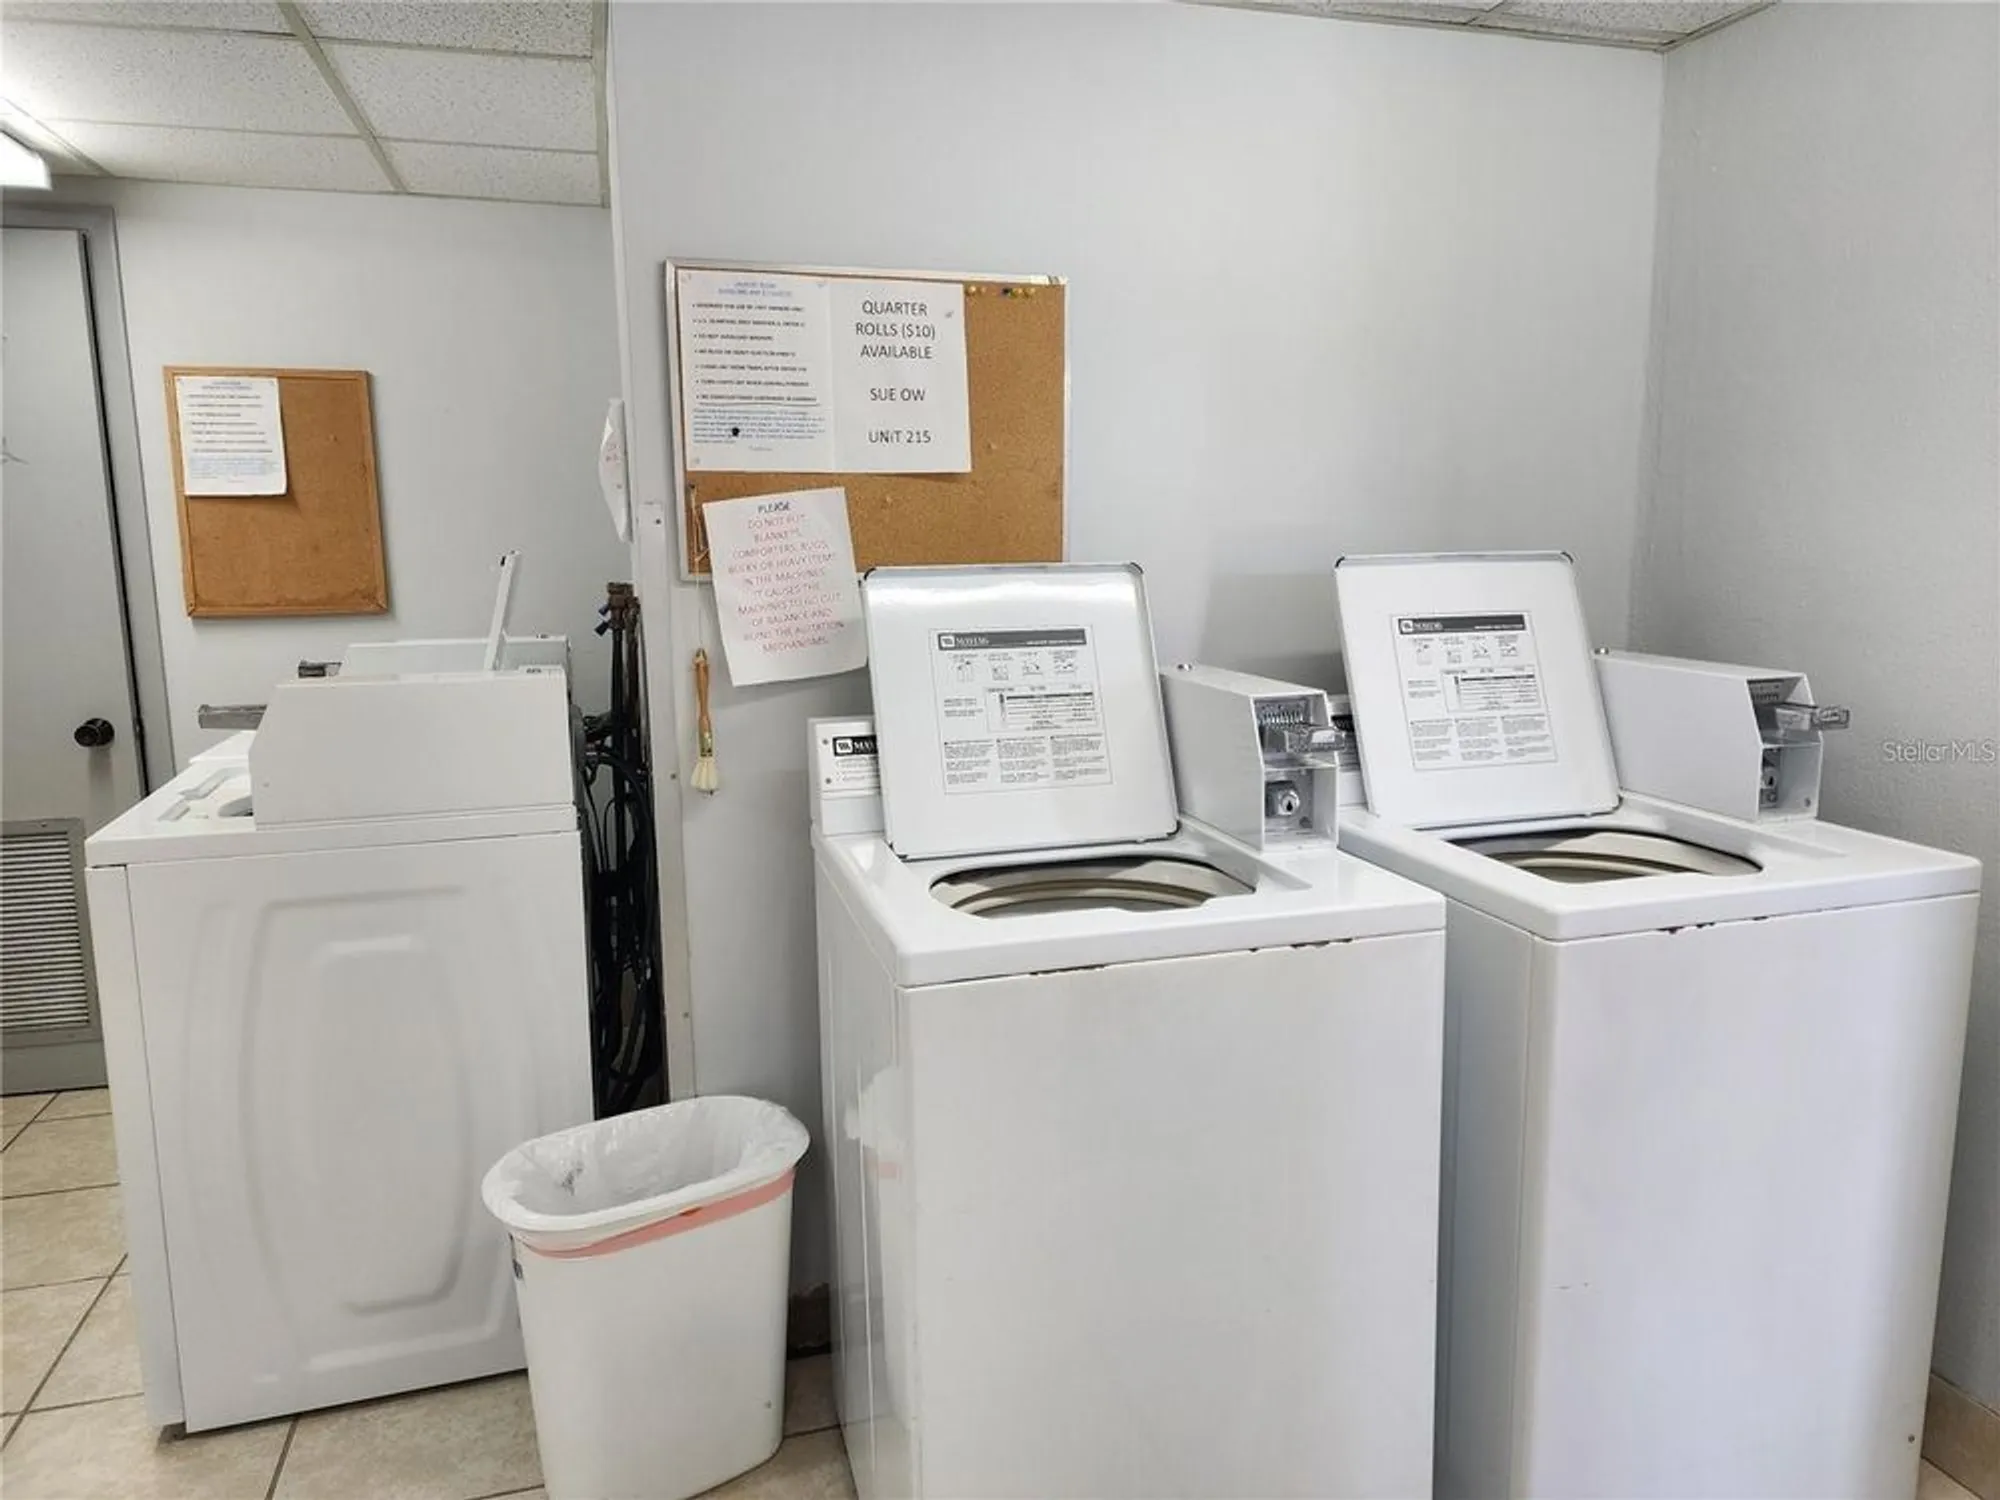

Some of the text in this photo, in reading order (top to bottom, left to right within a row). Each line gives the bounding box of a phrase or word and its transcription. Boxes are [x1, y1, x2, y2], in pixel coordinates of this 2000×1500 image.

[862, 300, 928, 316] QUARTER
[855, 322, 936, 340] ROLLS ($10)
[860, 344, 933, 359] AVAILABLE
[870, 387, 926, 401] SUE OW
[906, 430, 931, 443] 215
[748, 518, 763, 529] DO
[764, 515, 785, 526] NOT
